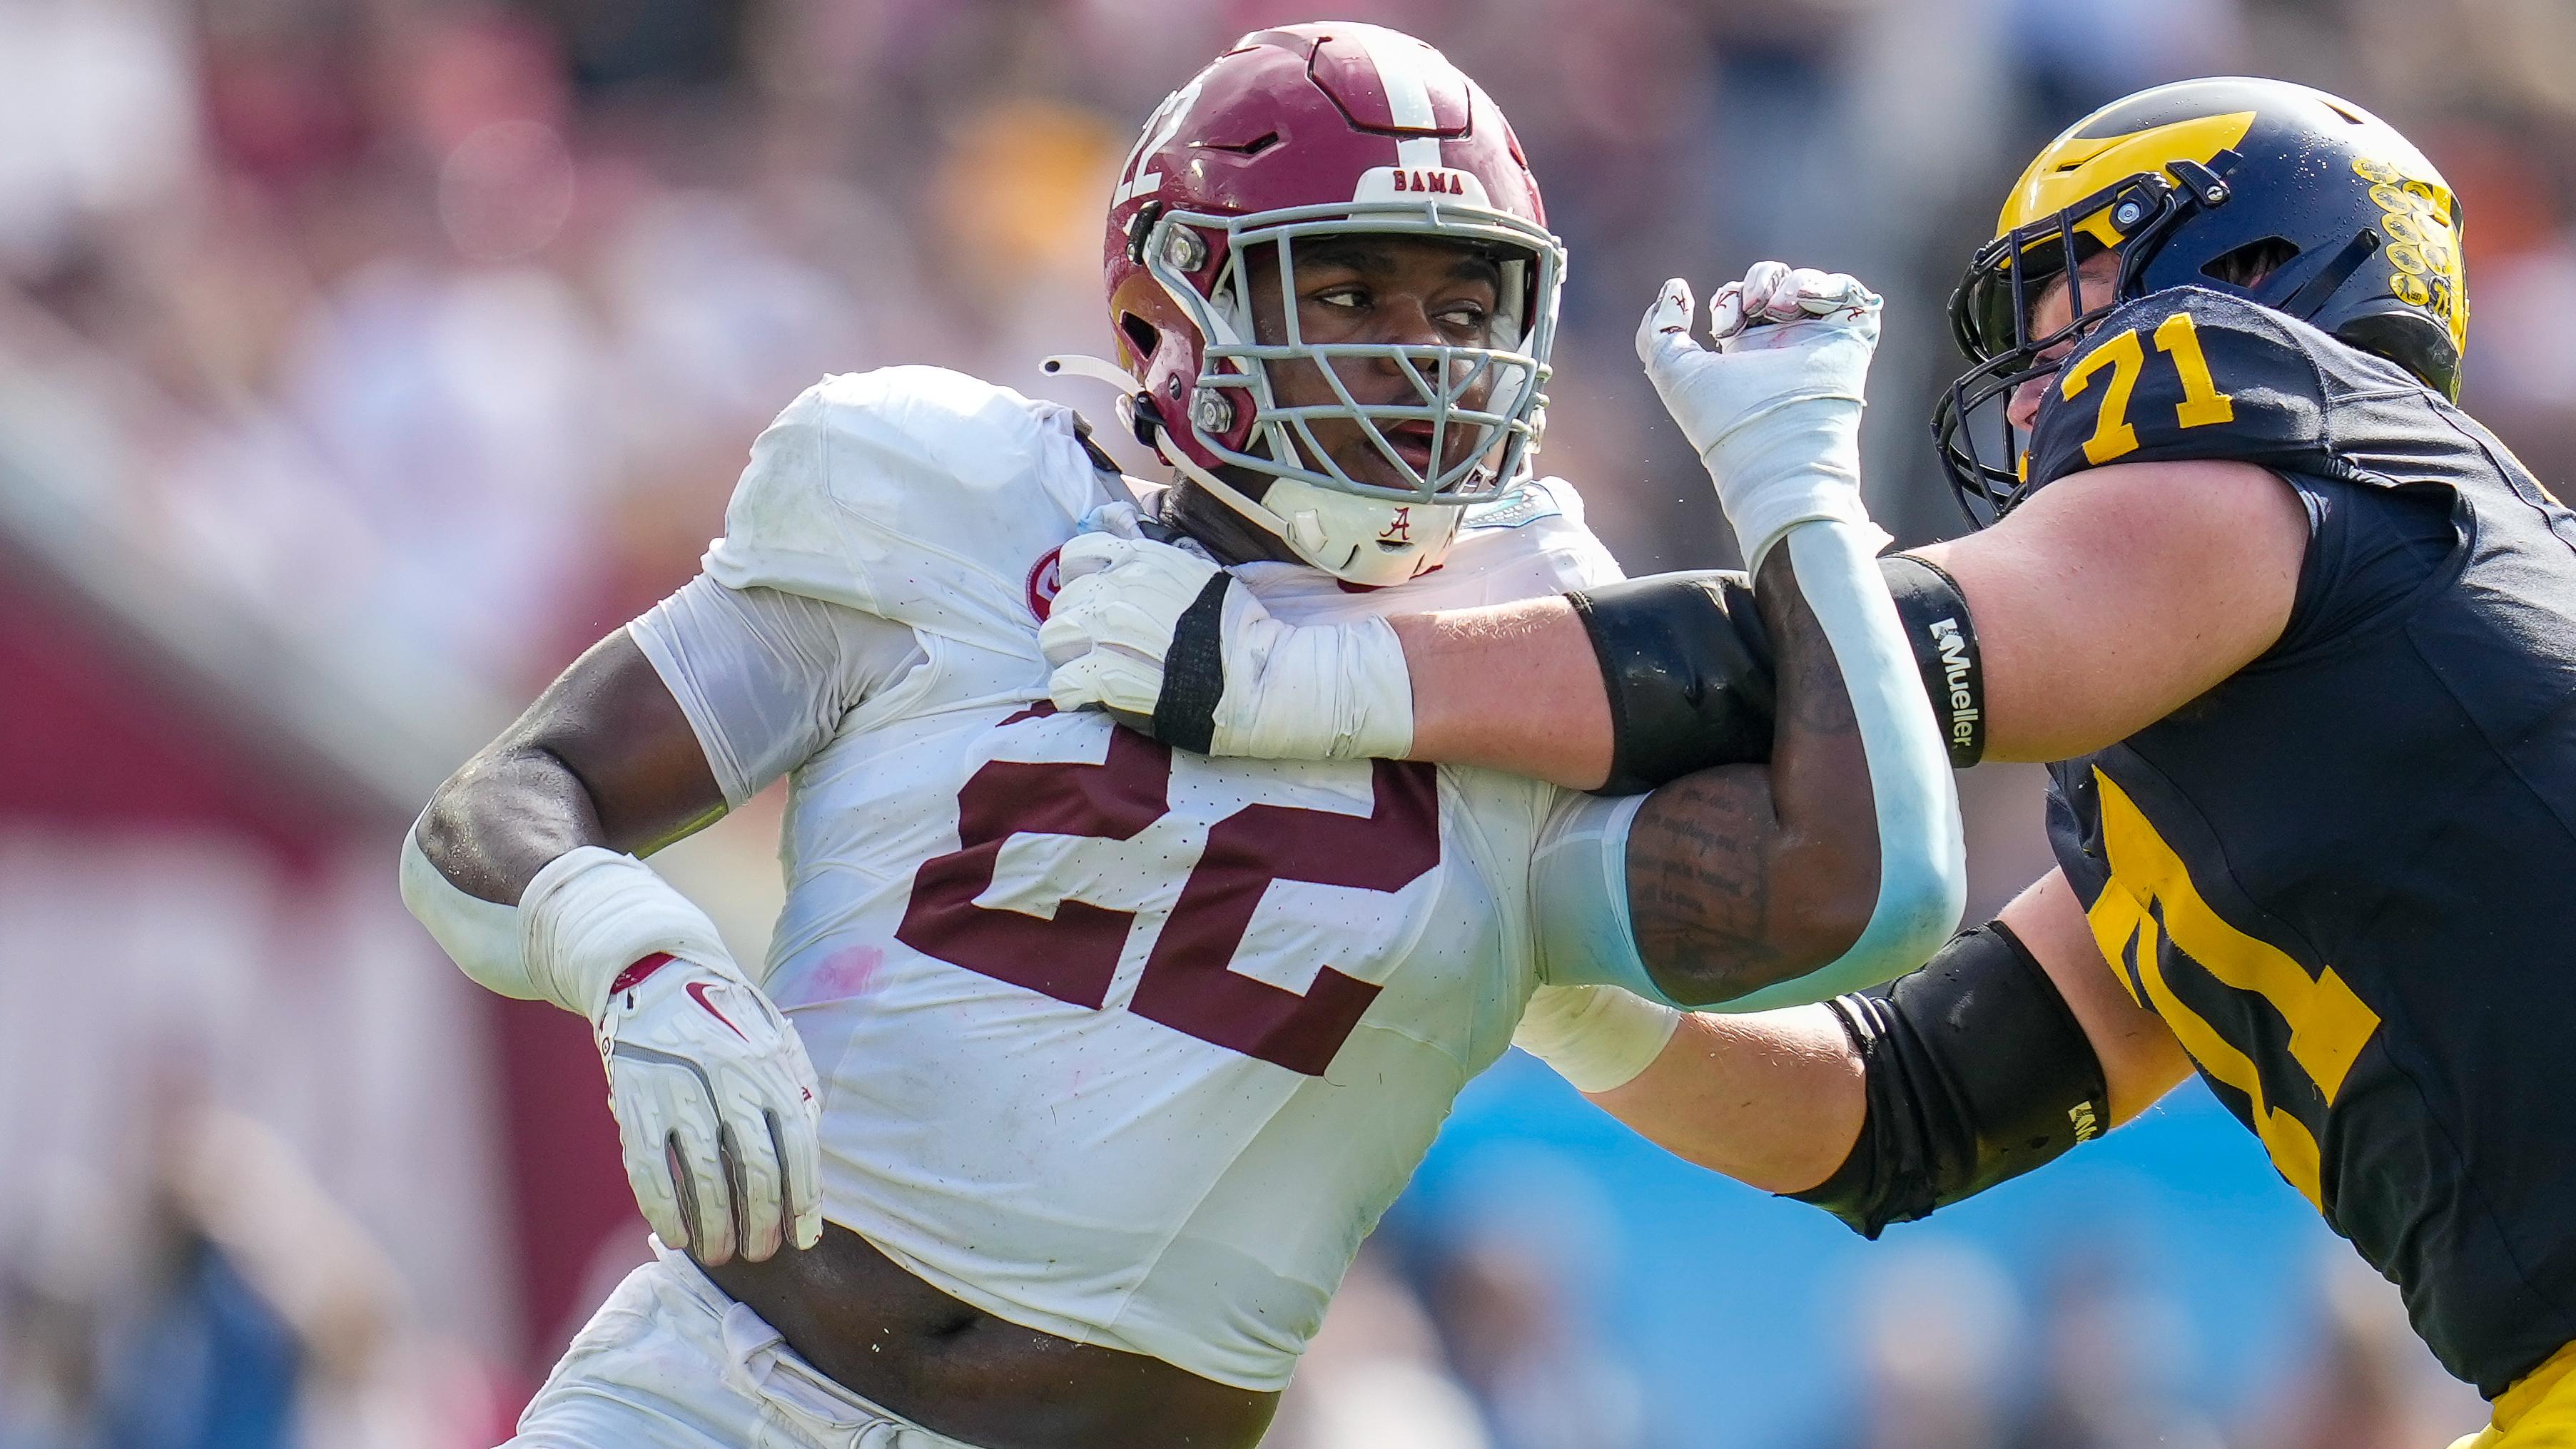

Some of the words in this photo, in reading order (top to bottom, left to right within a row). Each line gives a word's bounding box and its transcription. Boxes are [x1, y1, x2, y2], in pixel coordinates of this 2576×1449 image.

[1111, 81, 1203, 210] 22
[1393, 170, 1463, 195] BAMA
[2060, 312, 2234, 465] 71
[1379, 507, 1410, 540] A
[1938, 635, 1979, 748] Mueller
[895, 700, 1441, 1077] 22
